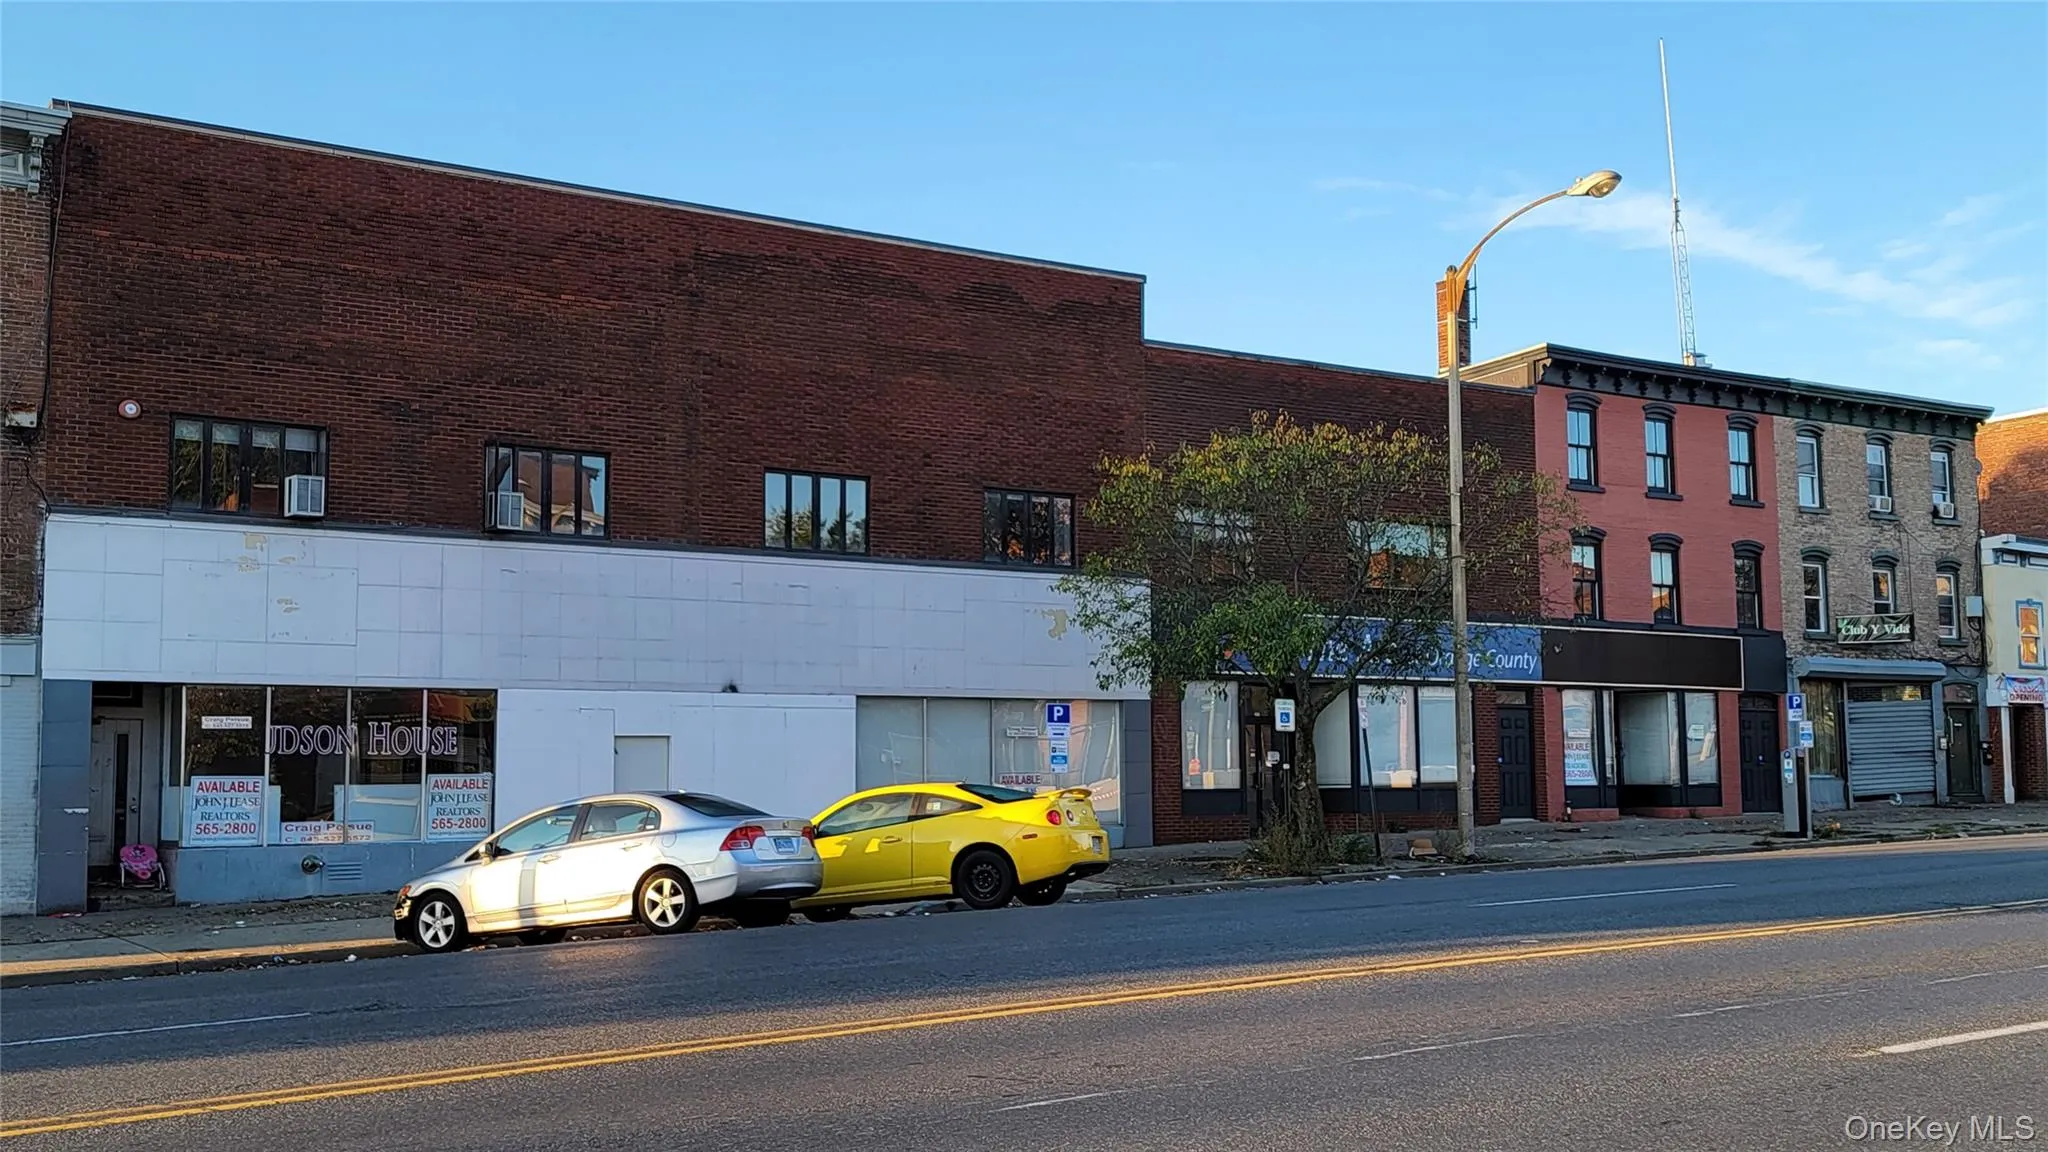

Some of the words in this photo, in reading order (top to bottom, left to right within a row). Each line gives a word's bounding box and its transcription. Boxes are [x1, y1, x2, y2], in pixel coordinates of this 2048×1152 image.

[1841, 624, 1868, 635] Club
[1871, 624, 1880, 634] Y
[1487, 648, 1538, 675] County
[1792, 696, 1801, 708] P
[1053, 706, 1064, 721] P
[432, 778, 489, 790] AVAILABLE
[1001, 775, 1042, 784] AVAILABLE
[196, 781, 260, 793] AVAILABLE
[193, 795, 221, 811] JOHN
[230, 796, 261, 809] LEASE
[429, 791, 455, 807] JOHN
[462, 793, 489, 804] LEASE
[200, 811, 251, 821] REALTORS
[436, 807, 482, 817] REALTORS
[195, 822, 257, 835] 565-2800
[284, 823, 322, 833] Craig
[432, 817, 487, 830] 565-2800
